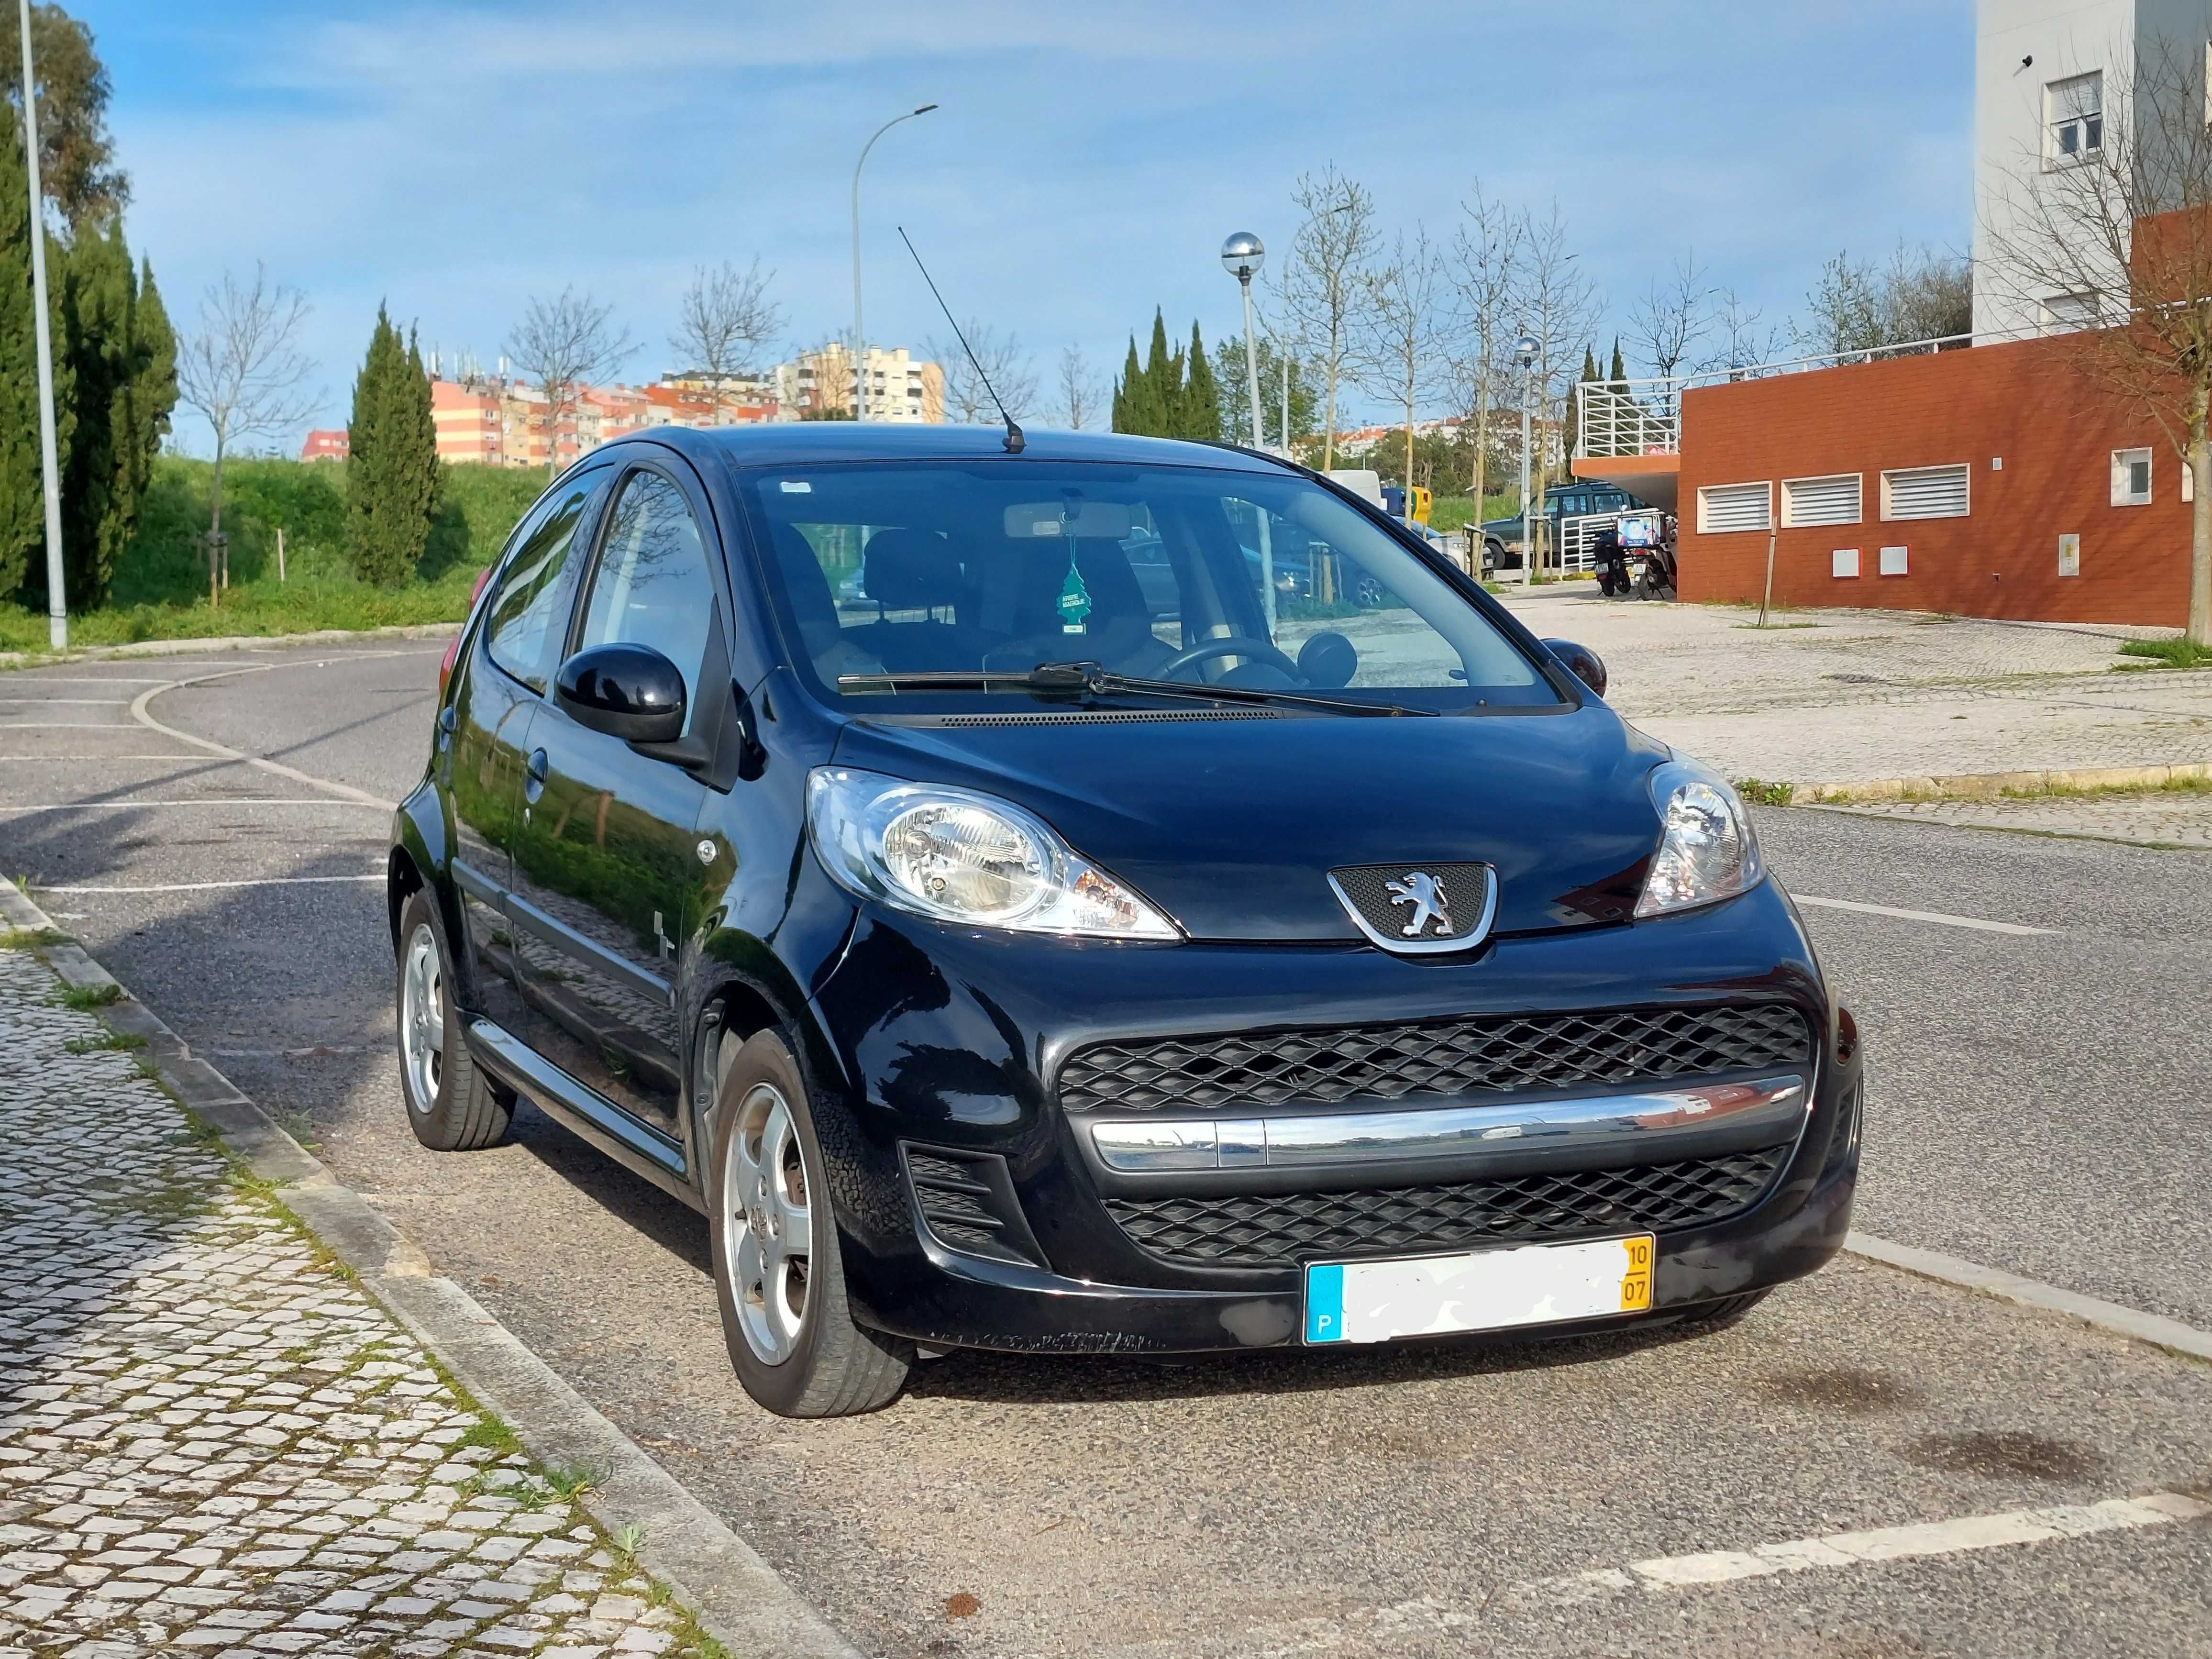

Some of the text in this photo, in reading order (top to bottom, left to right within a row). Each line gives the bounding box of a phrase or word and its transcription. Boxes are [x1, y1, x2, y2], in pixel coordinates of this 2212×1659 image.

[1630, 1245, 1647, 1264] 10
[1625, 1281, 1645, 1301] 07
[1318, 1314, 1332, 1335] P
